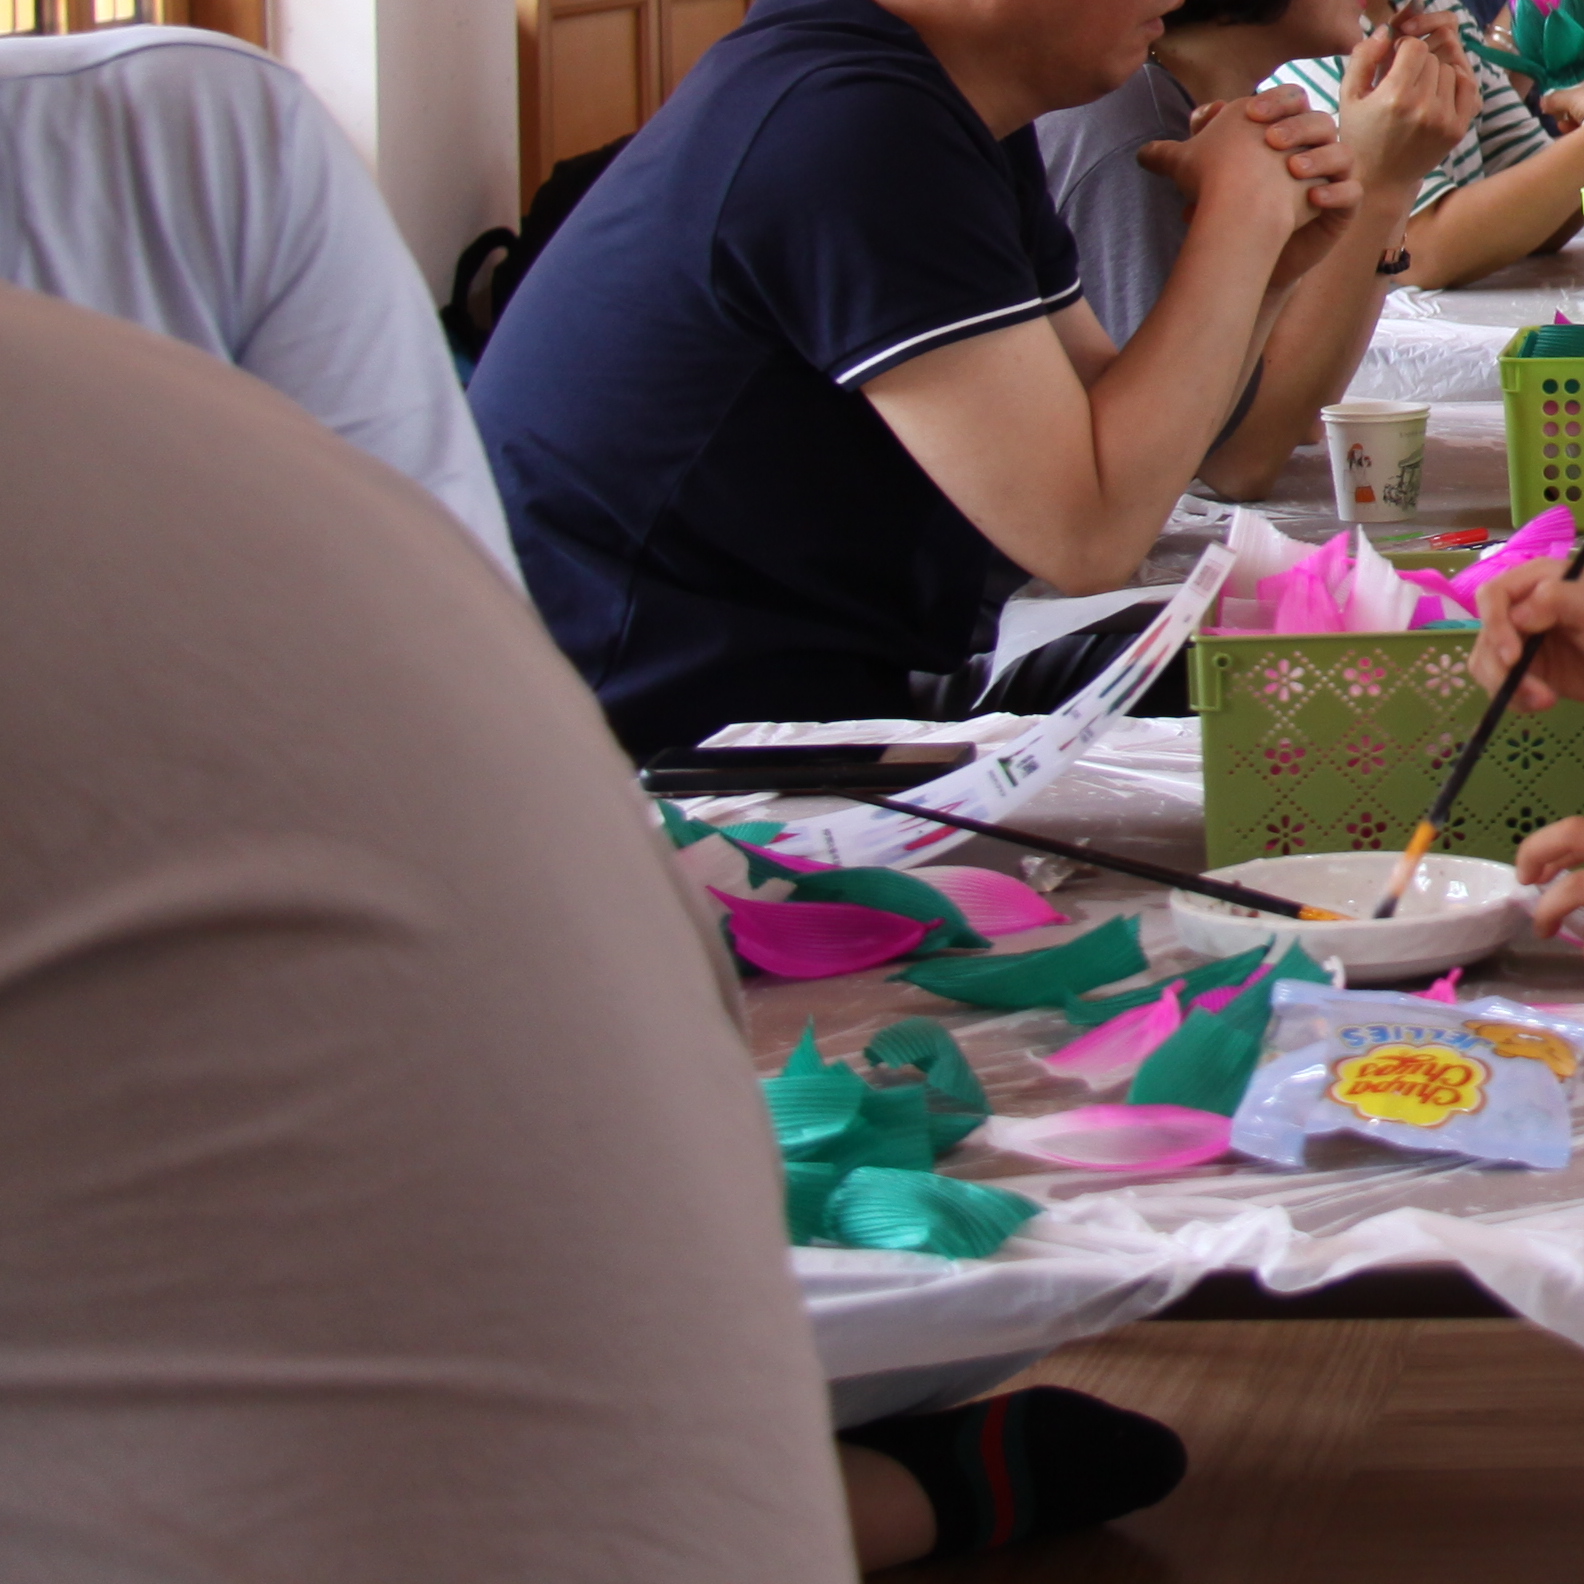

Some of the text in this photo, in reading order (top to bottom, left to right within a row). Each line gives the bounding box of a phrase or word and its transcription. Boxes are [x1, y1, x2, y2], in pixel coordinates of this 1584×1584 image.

[1341, 1024, 1493, 1051] JELLIES
[1355, 1053, 1474, 1088] Chups
[1345, 1077, 1462, 1107] Chupa
